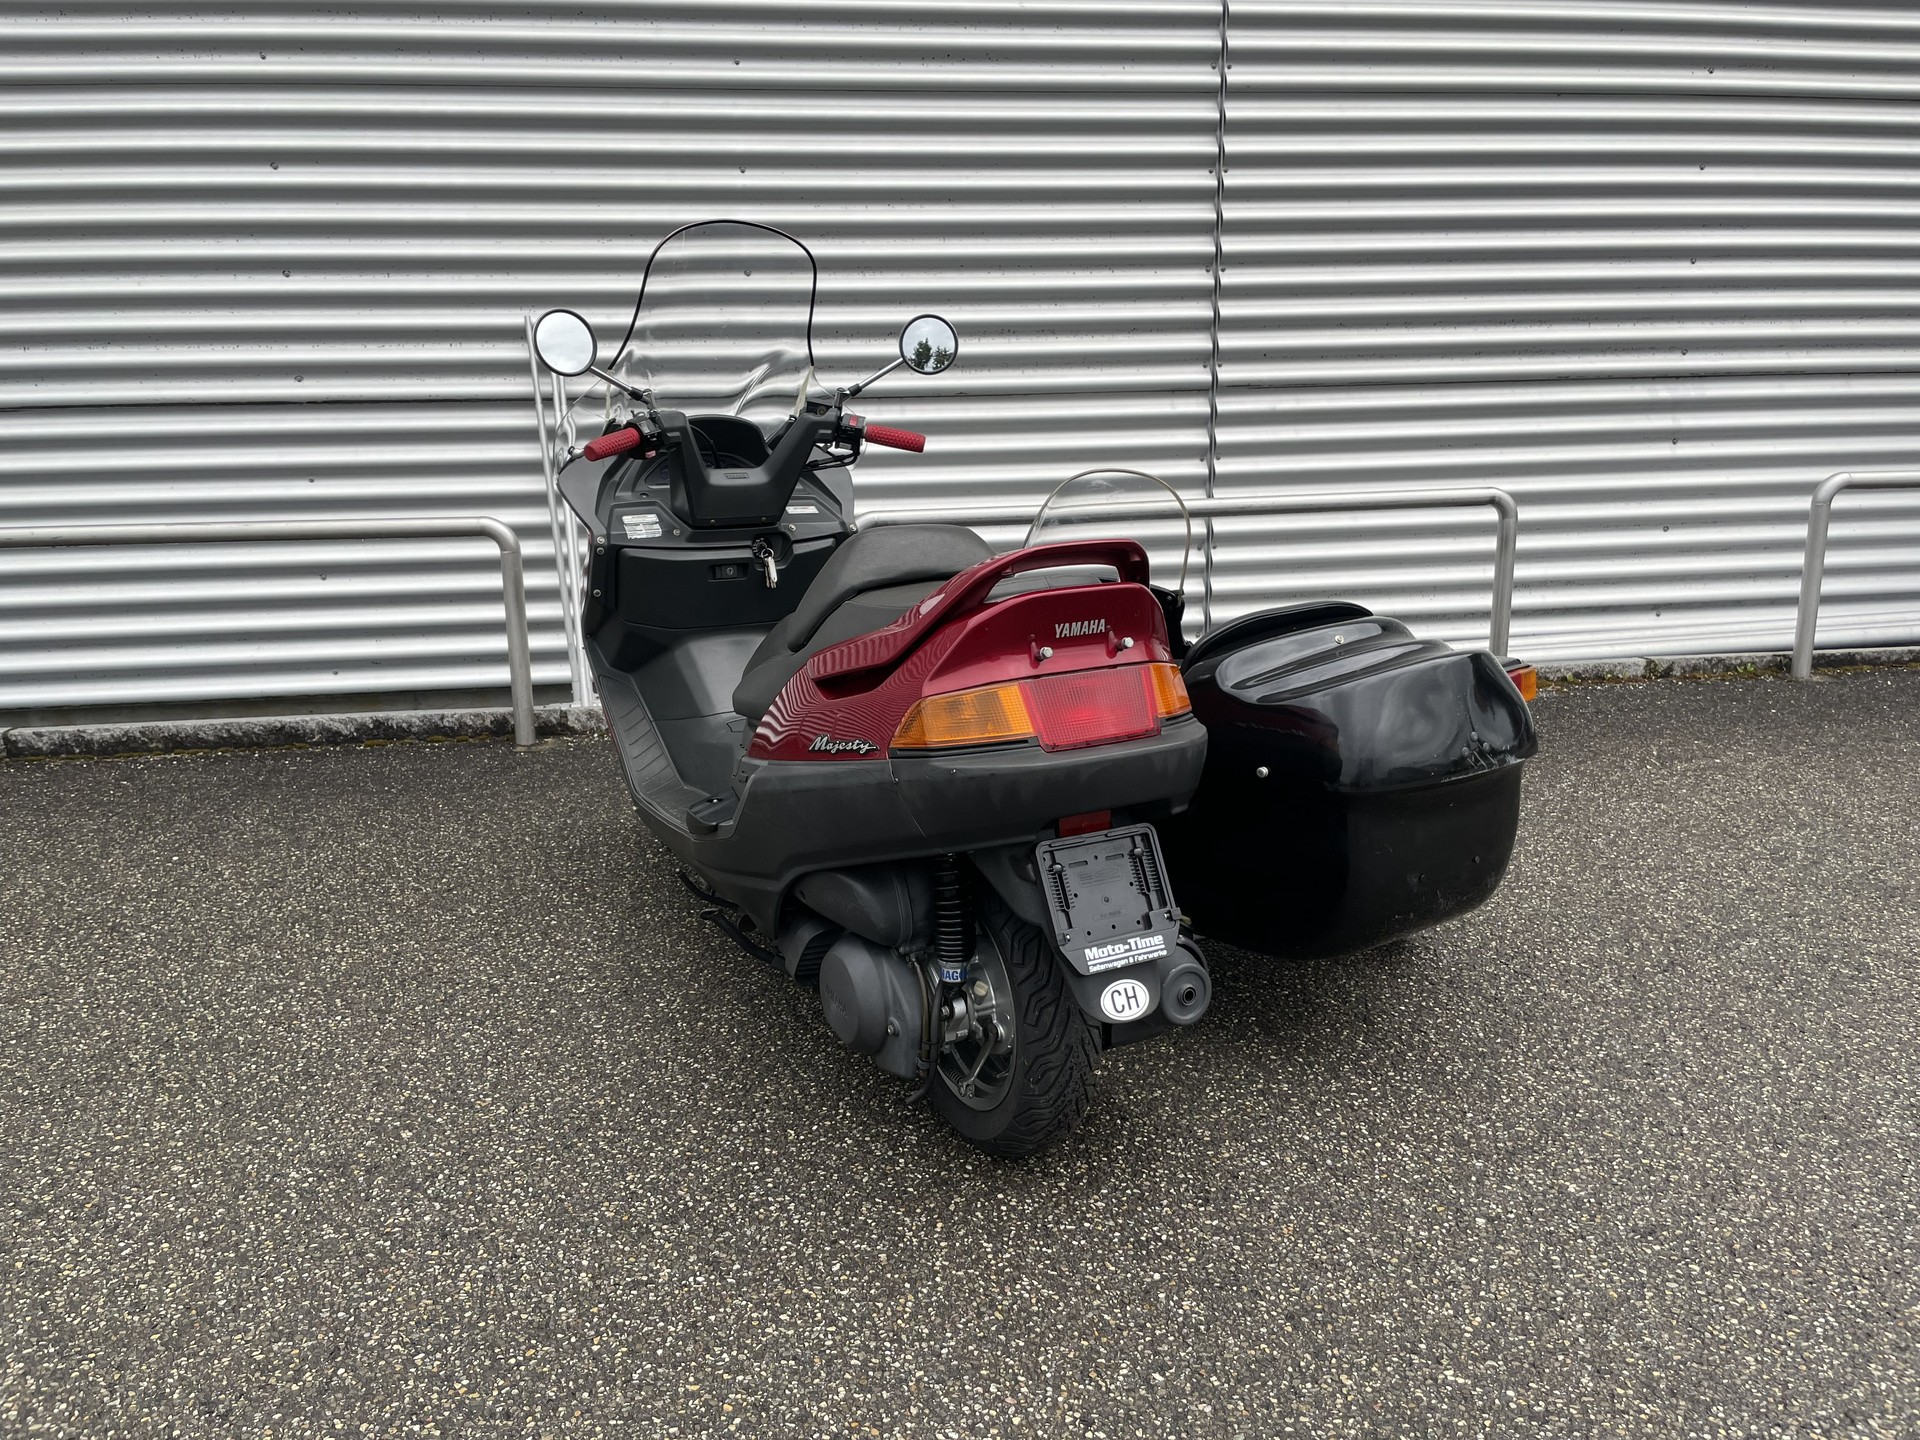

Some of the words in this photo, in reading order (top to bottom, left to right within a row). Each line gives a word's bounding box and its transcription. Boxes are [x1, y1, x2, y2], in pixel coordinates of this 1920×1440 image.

[1055, 618, 1105, 638] YAMAHA
[808, 736, 877, 754] Majesty
[1084, 934, 1164, 961] Moto-Time
[1089, 957, 1129, 973] Seitenwagen
[1128, 956, 1135, 964] &
[1110, 985, 1140, 1014] CH
